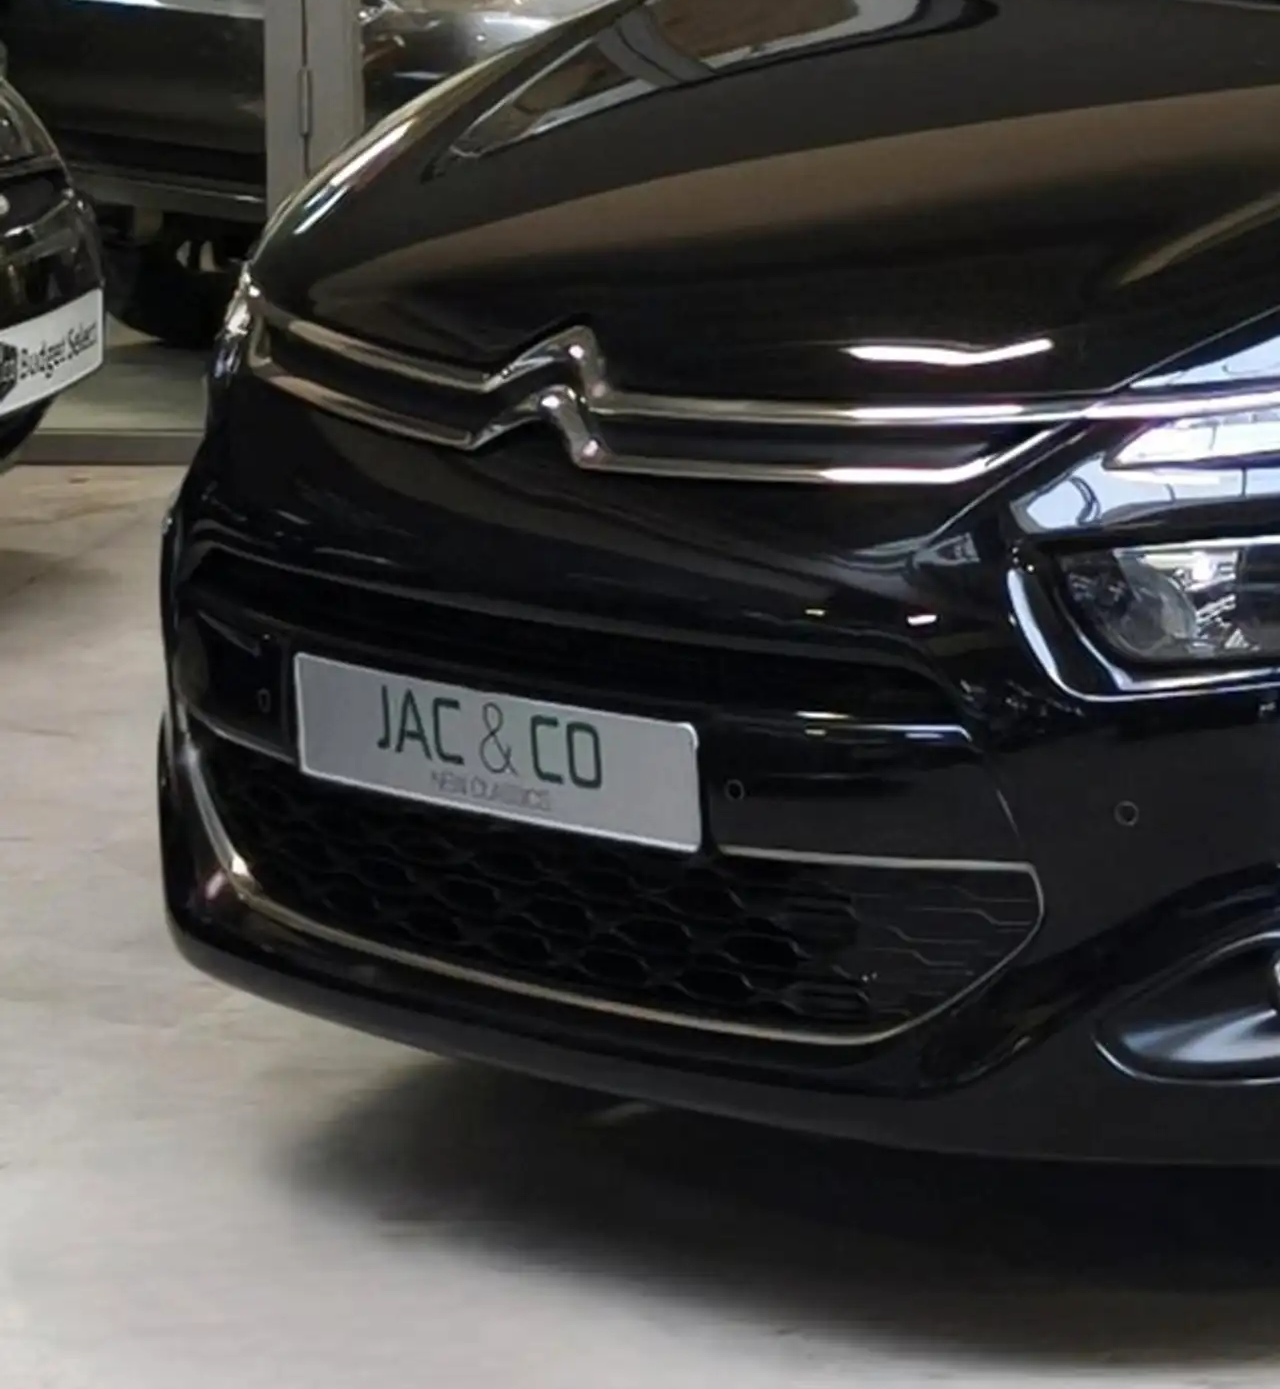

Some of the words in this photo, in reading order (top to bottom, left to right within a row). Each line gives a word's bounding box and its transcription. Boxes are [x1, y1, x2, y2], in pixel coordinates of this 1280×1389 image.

[20, 338, 66, 379] Budget
[376, 684, 465, 766] JAC
[479, 701, 519, 775] &
[530, 714, 602, 789] CO
